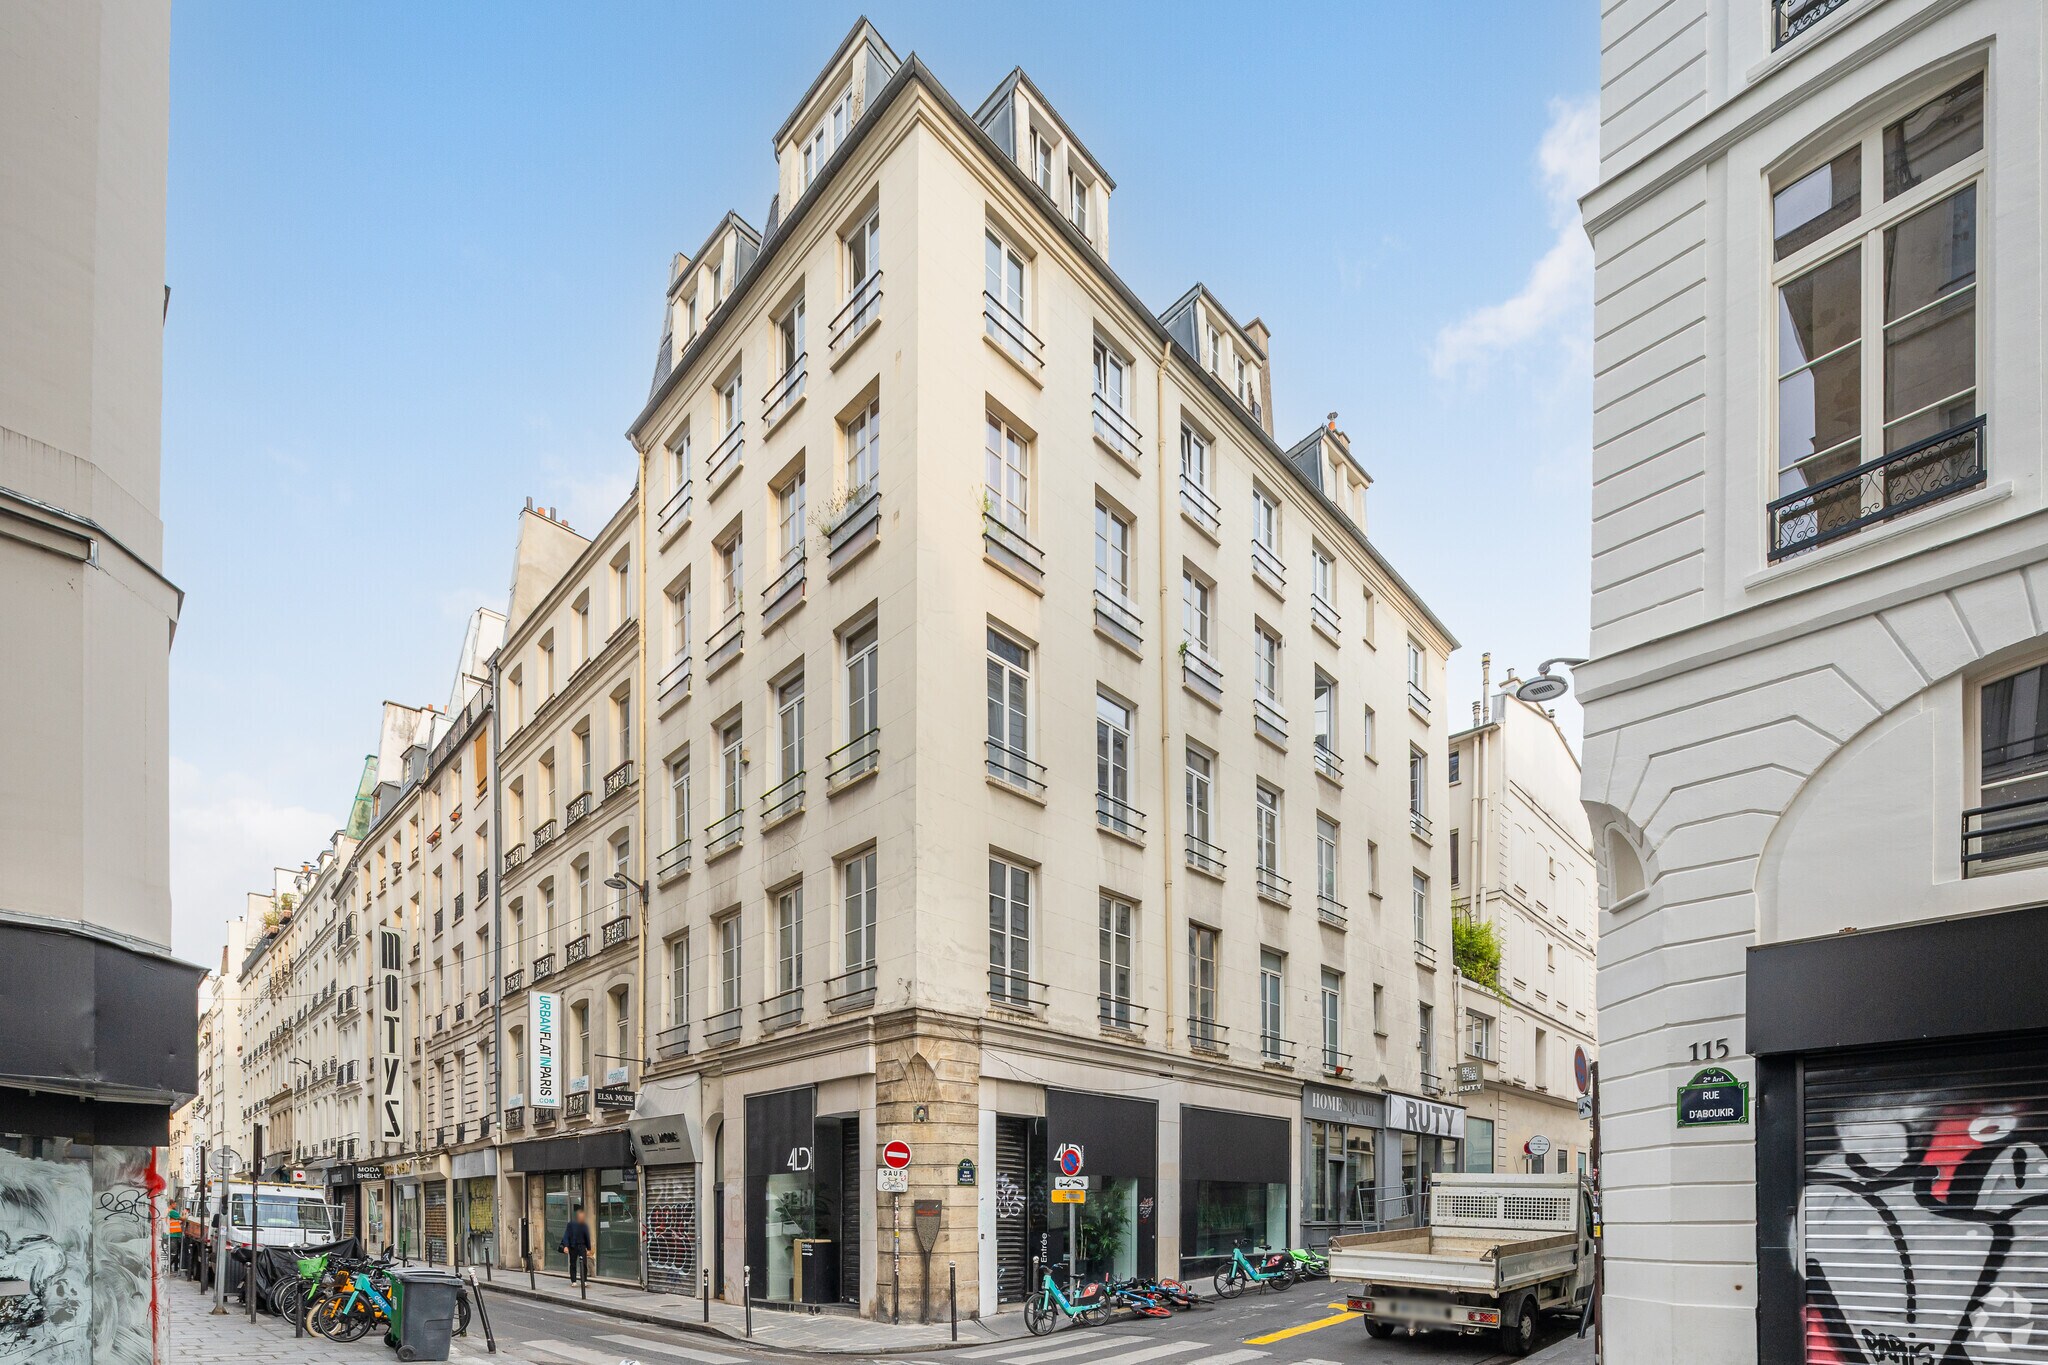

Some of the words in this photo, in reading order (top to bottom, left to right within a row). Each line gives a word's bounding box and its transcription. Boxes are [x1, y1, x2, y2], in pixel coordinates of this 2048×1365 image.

[1689, 1038, 1729, 1062] 115
[1459, 1084, 1482, 1092] RUTY
[597, 1092, 613, 1101] ELSA
[615, 1094, 634, 1102] MODE
[1702, 1091, 1720, 1100] RUE
[1405, 1100, 1455, 1136] RUTY
[1689, 1108, 1734, 1119] D'ABOUKIR
[1040, 1232, 1048, 1263] Entrée
[374, 1295, 388, 1309] dott
